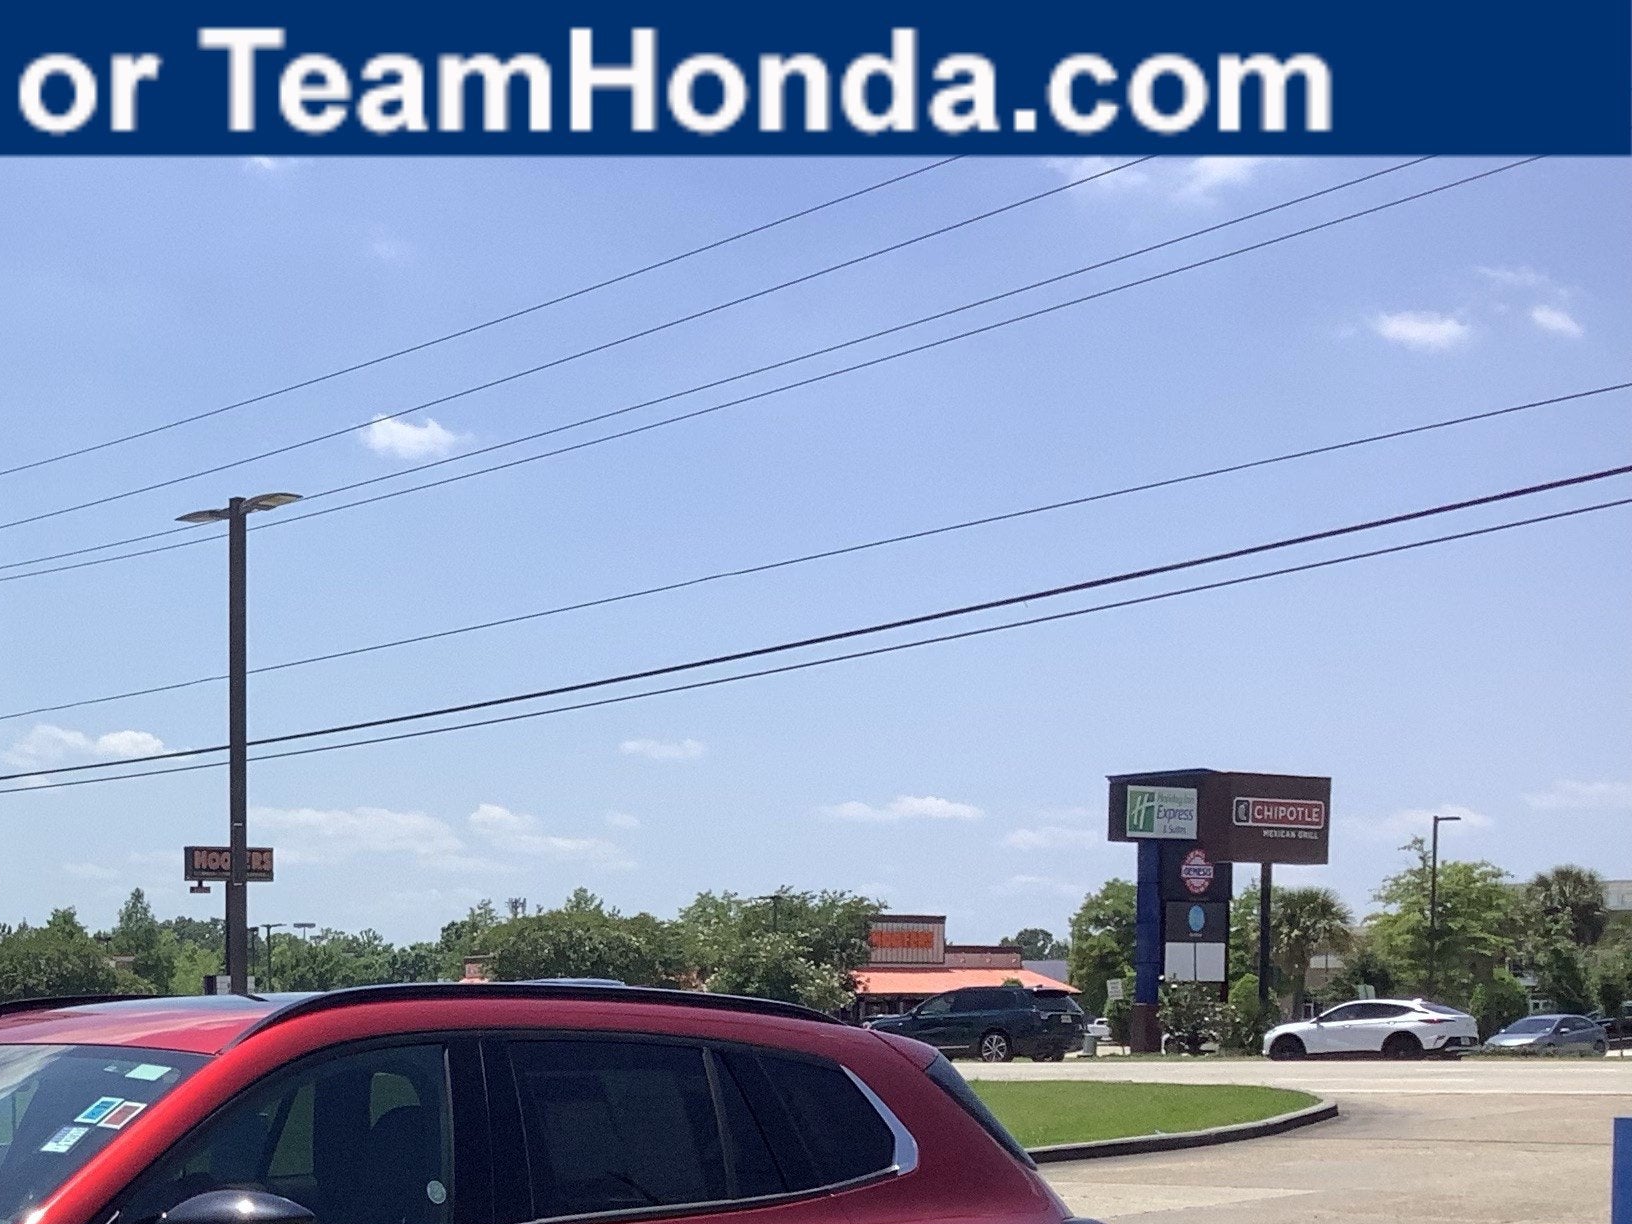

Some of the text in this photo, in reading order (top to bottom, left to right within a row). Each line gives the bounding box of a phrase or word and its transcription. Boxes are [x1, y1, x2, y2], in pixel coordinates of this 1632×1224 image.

[1157, 804, 1194, 823] Express
[1254, 805, 1320, 822] CHIPOTLE
[194, 850, 273, 871] HOORS
